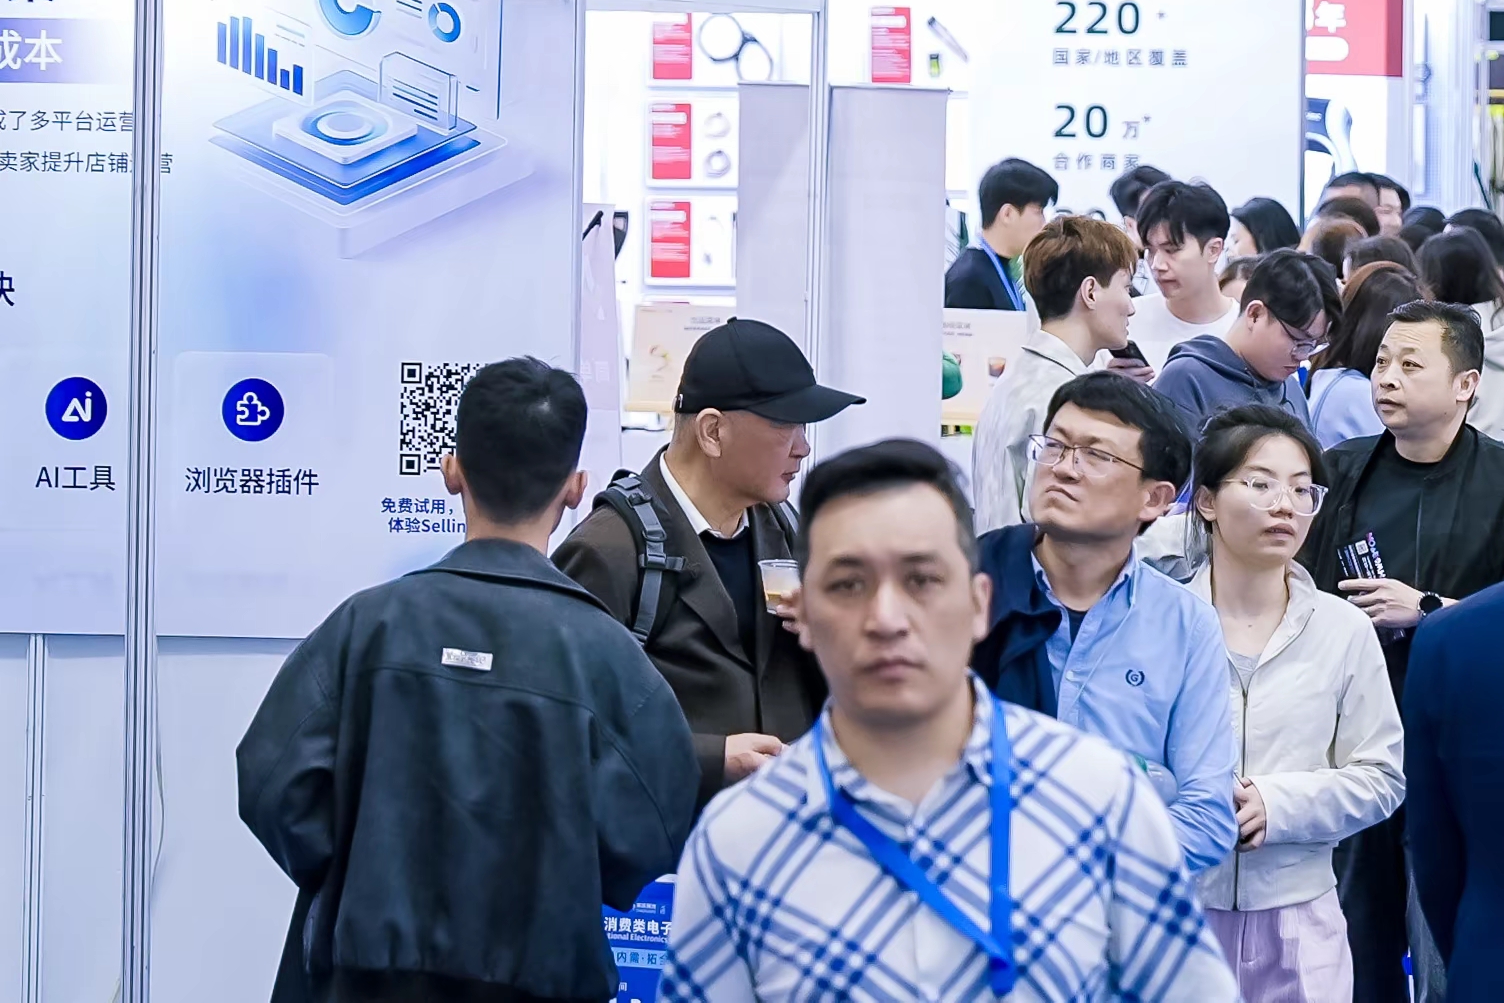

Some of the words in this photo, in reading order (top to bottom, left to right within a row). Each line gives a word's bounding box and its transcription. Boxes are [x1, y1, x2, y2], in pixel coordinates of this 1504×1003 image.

[1055, 1, 1140, 34] 220
[1053, 49, 1189, 66] 国家/地区覆盖
[1053, 104, 1108, 137] 20
[0, 151, 173, 174] 卖家提升店铺营
[1053, 154, 1140, 170] 合作商家
[35, 465, 116, 491] AI工具
[185, 466, 319, 495] 浏览器插件
[381, 497, 454, 515] 免费试用，
[603, 916, 672, 936] 消费类电子
